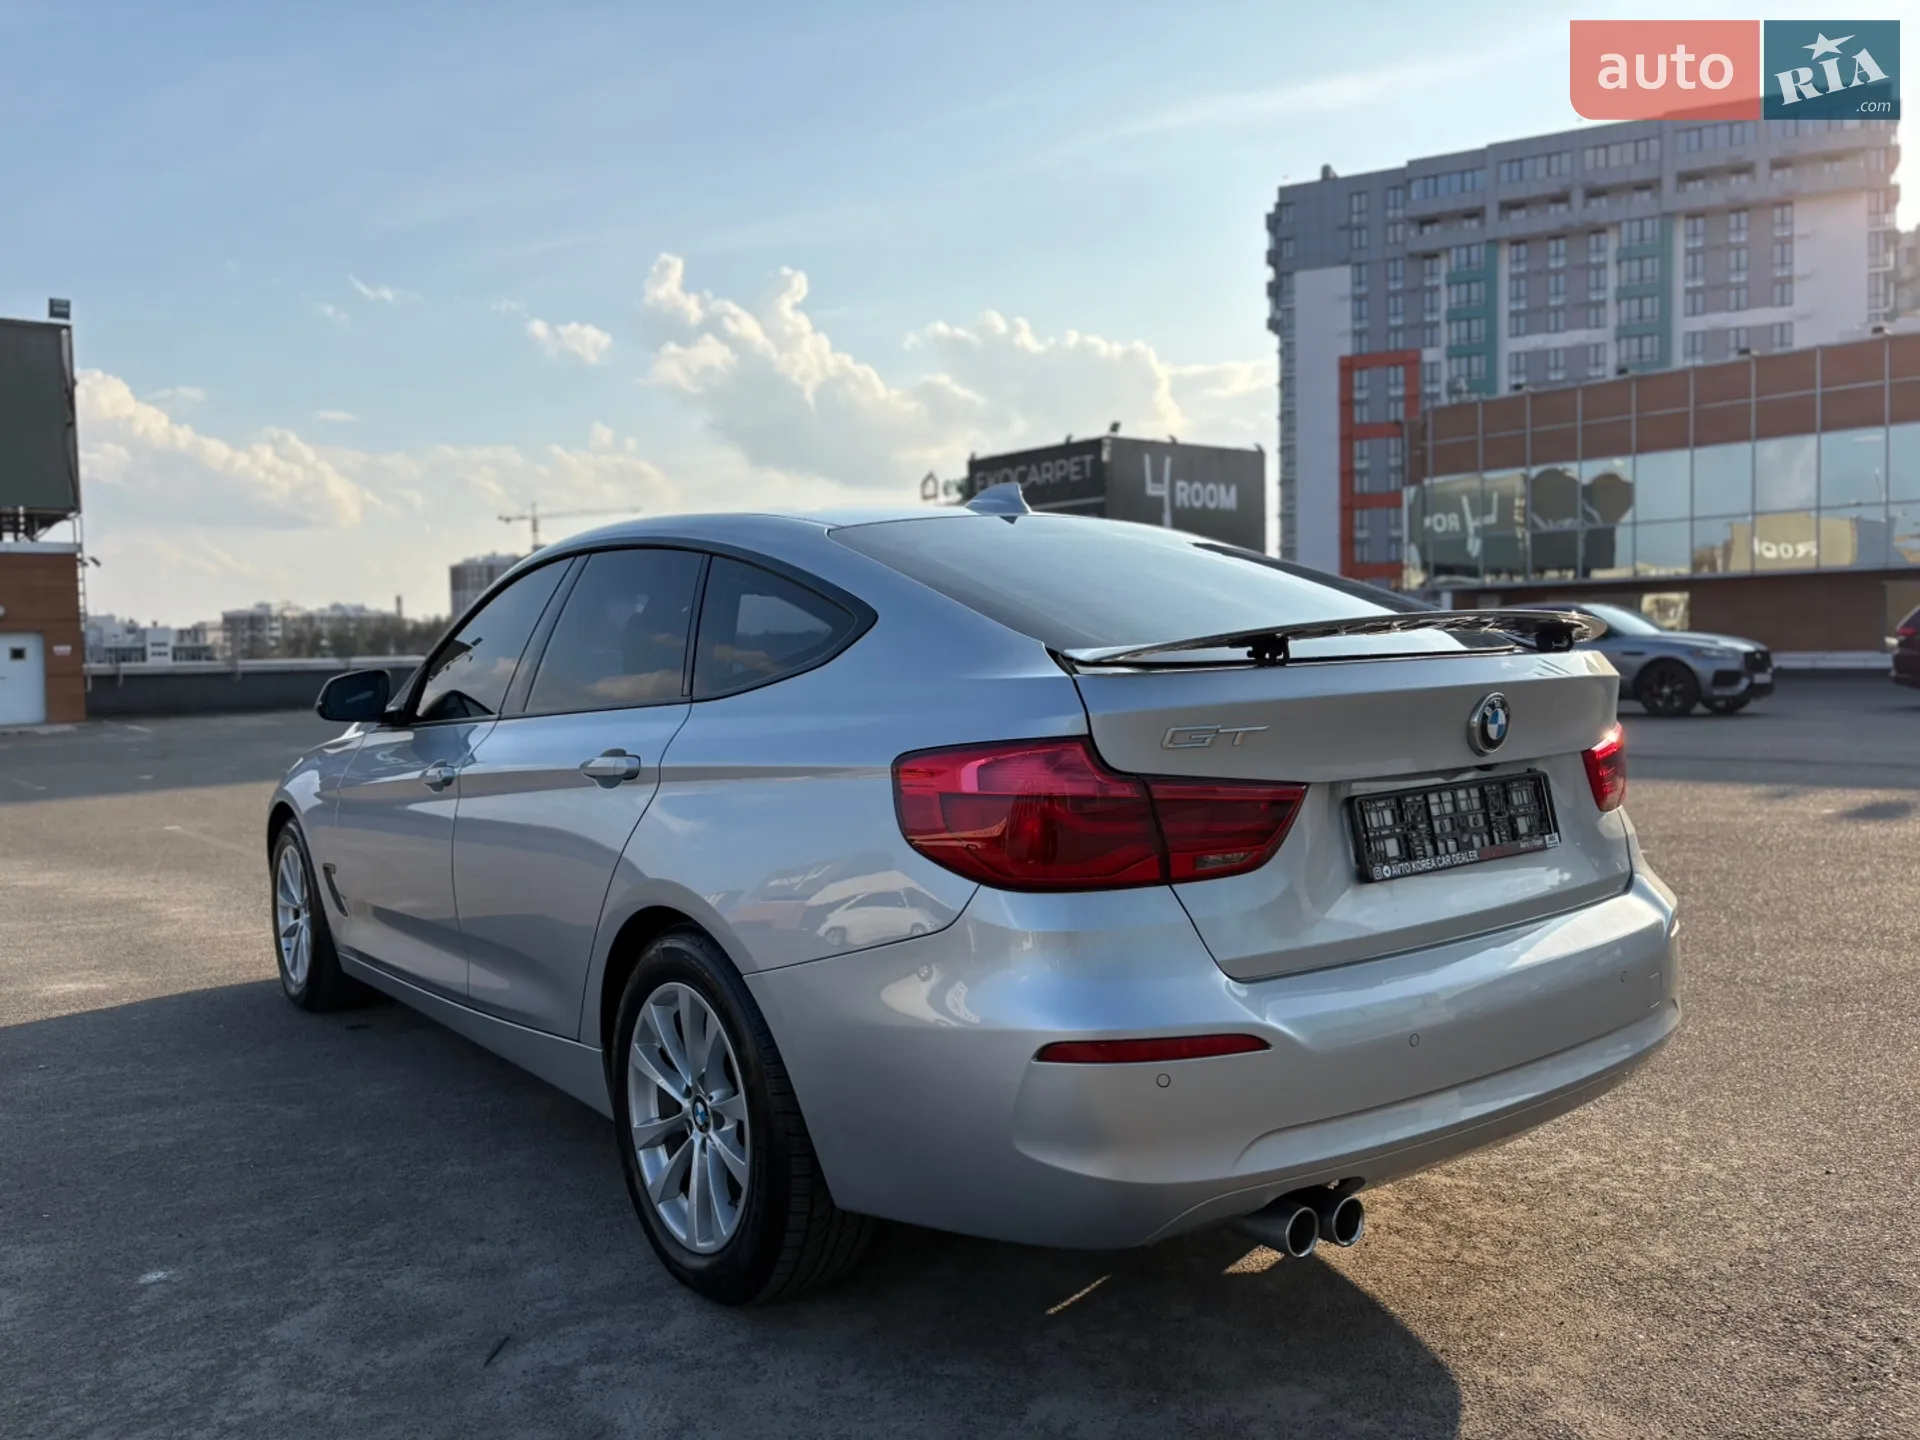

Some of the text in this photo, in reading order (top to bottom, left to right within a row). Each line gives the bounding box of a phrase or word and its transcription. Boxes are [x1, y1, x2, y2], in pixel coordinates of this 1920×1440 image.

[1144, 453, 1238, 529] 4 ROOM
[1161, 725, 1270, 749] GT
[1411, 857, 1437, 873] KOREA
[1436, 854, 1452, 868] CAR
[1452, 850, 1480, 864] DEALER
